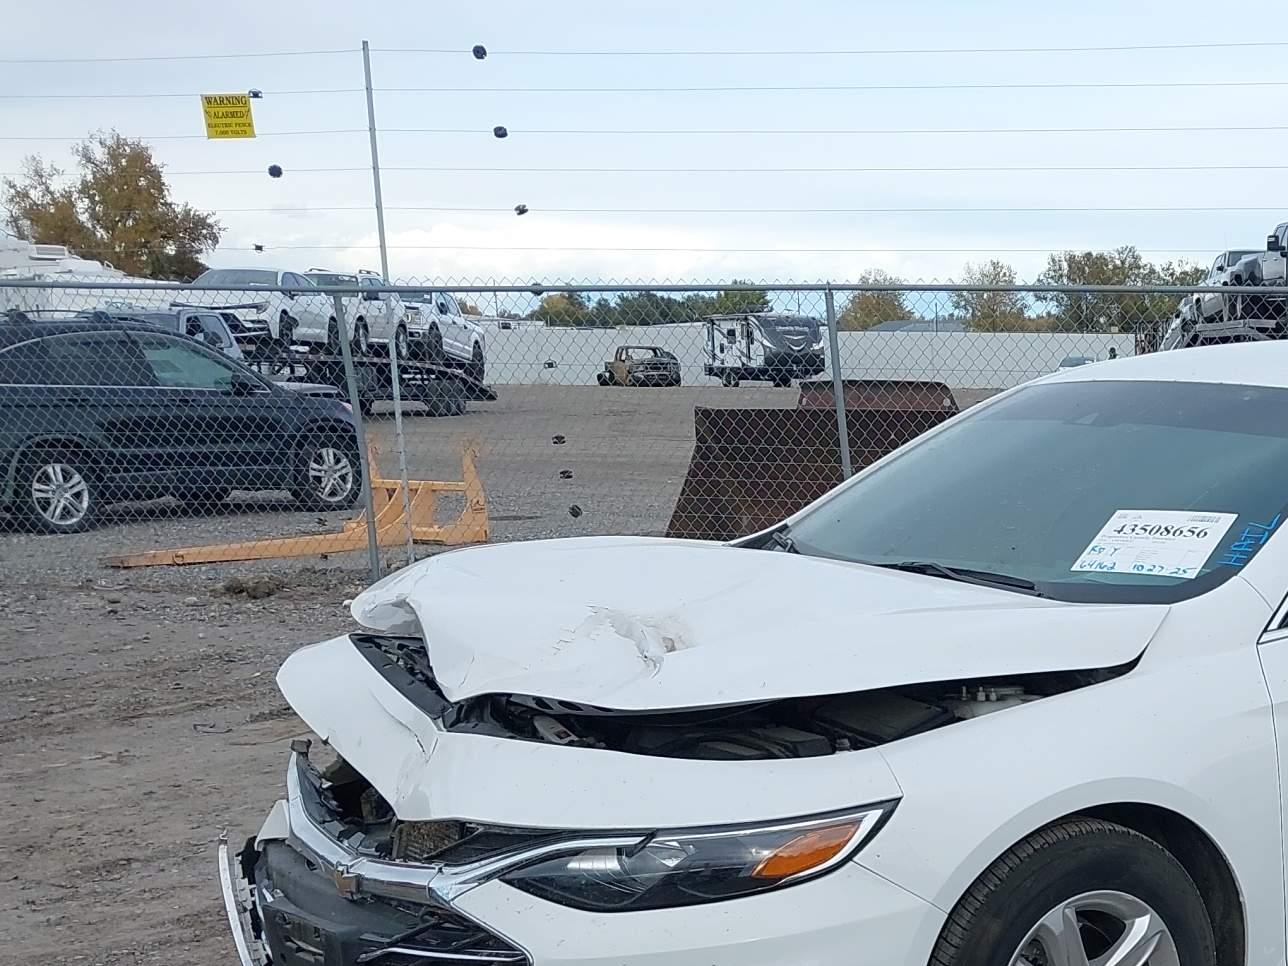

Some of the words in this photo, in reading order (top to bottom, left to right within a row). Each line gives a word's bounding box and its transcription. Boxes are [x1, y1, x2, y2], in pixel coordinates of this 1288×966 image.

[204, 96, 247, 106] WARNING
[213, 111, 245, 119] ALARMED
[1113, 523, 1209, 539] 43508656
[1217, 513, 1281, 566] HAIL
